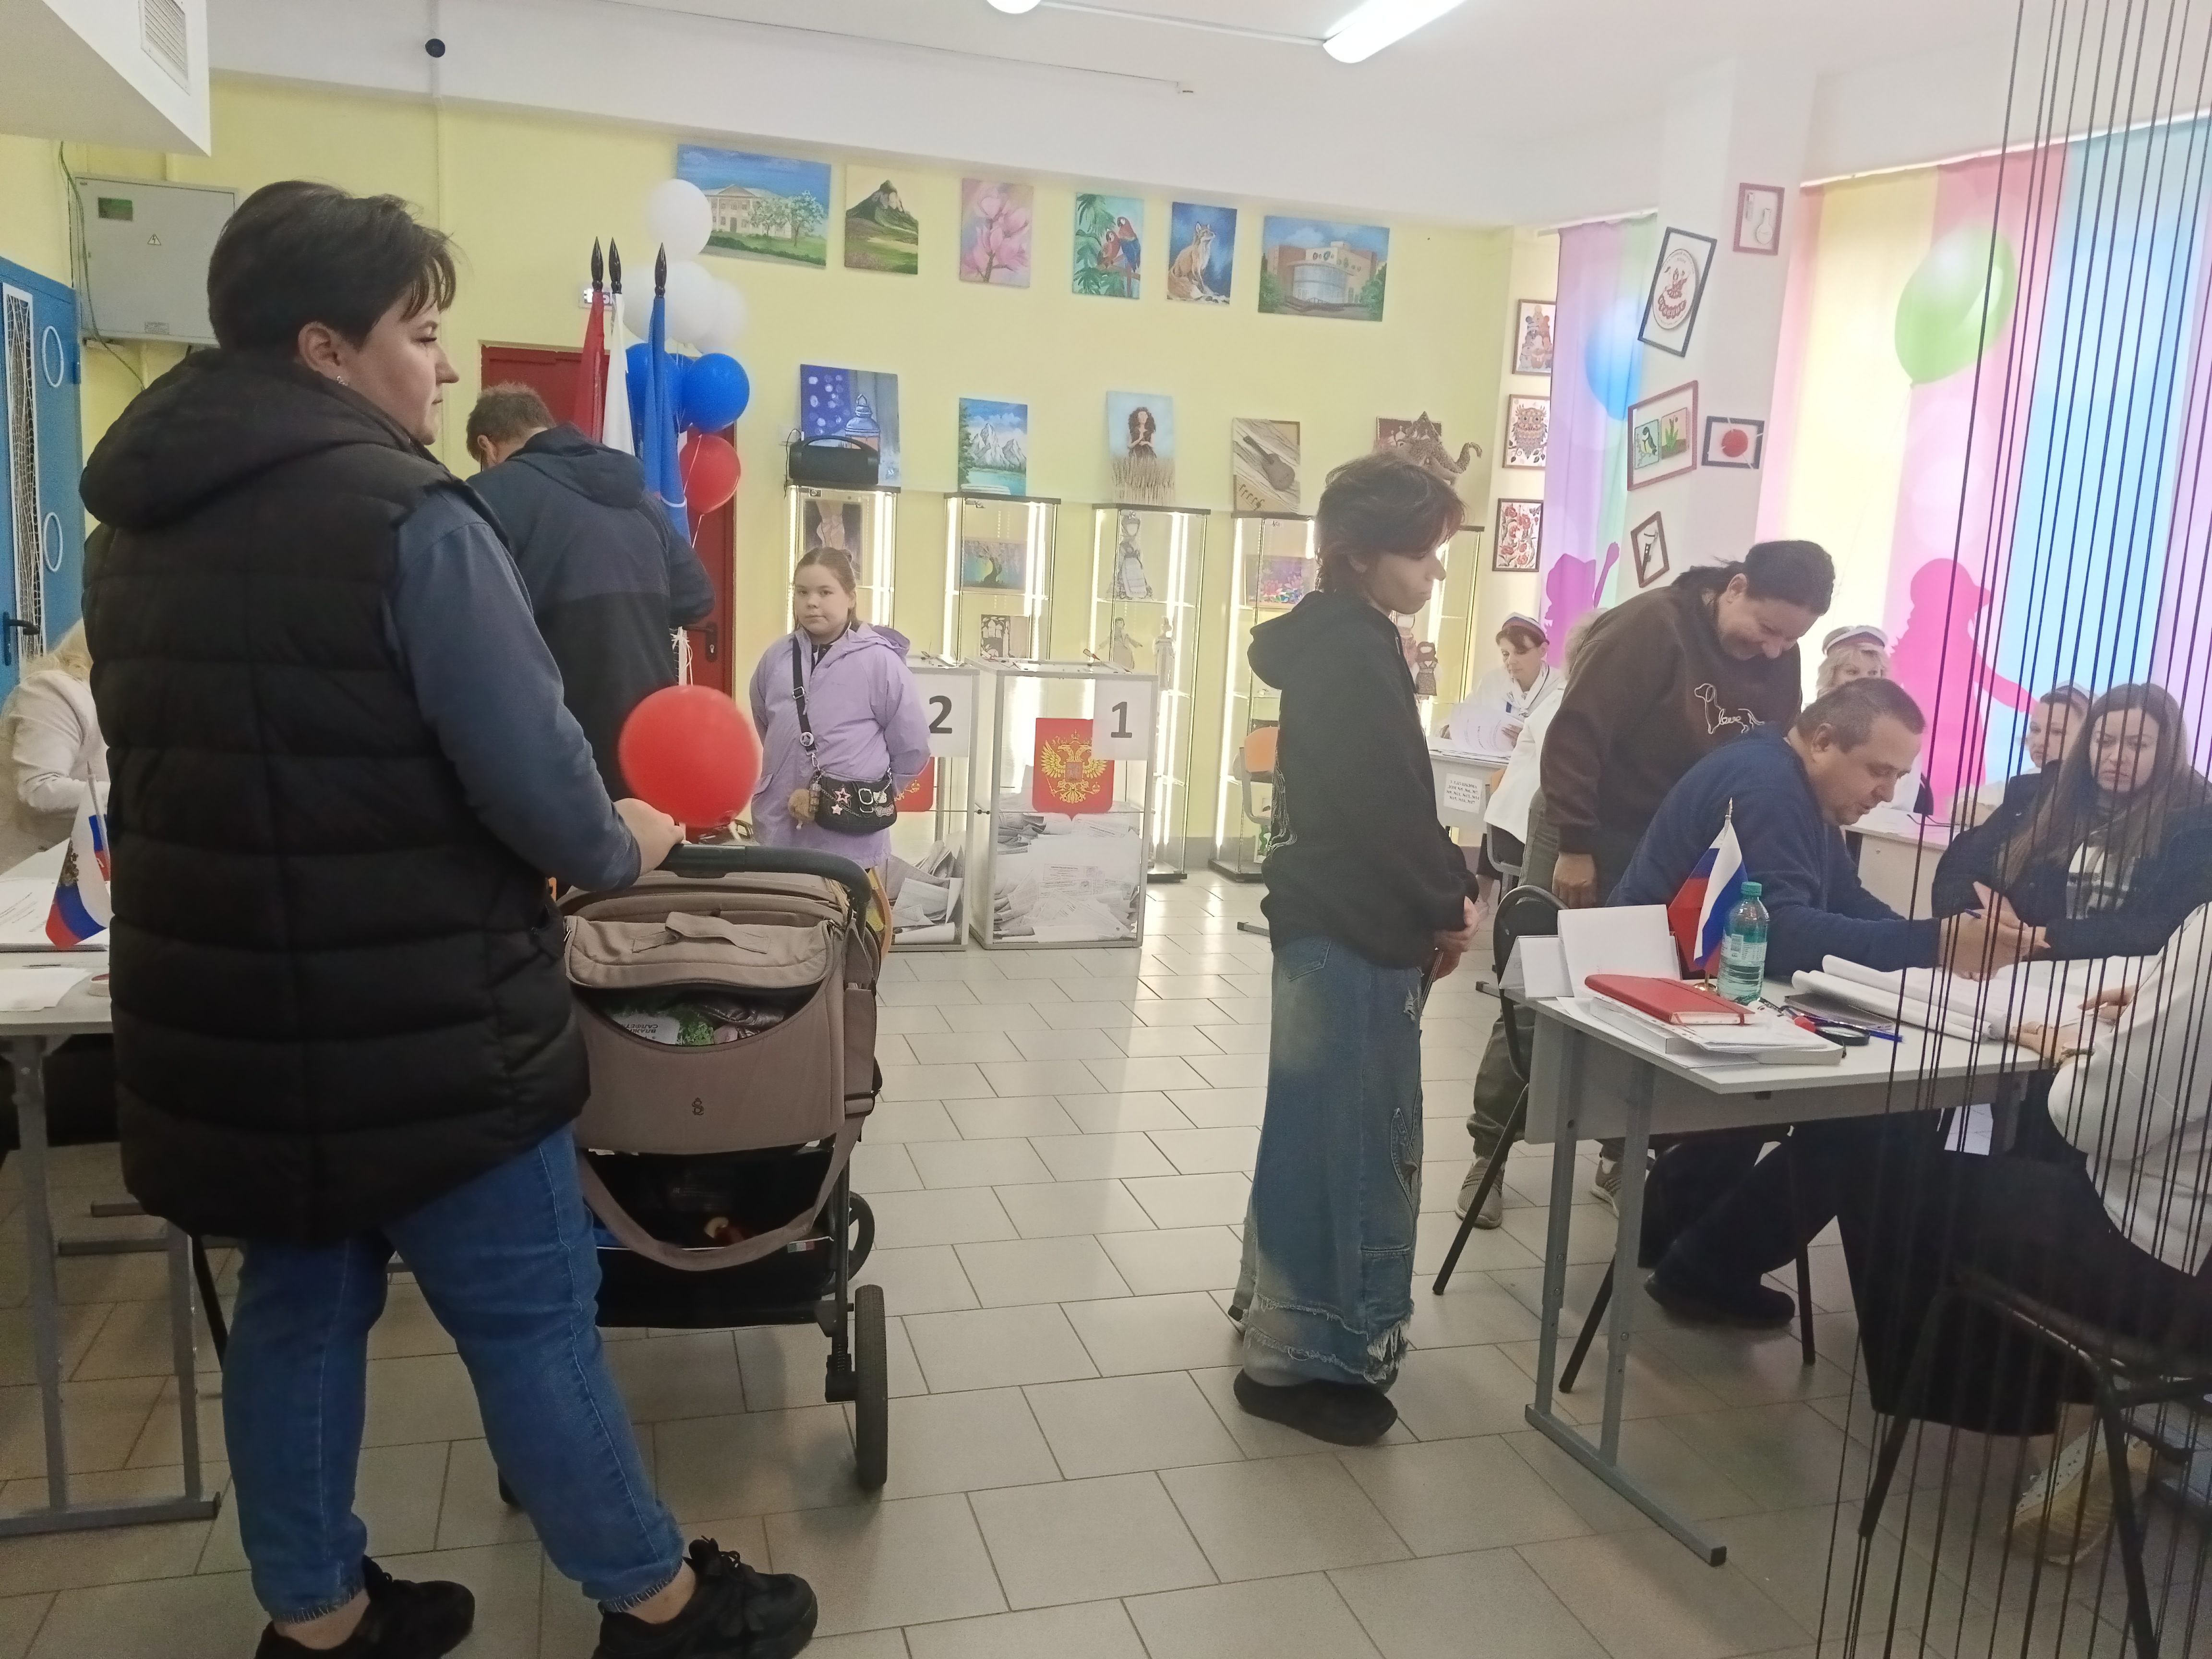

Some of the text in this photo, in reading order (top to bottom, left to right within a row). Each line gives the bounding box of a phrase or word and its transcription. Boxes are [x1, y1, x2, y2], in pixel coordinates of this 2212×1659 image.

[929, 696, 952, 734] 2
[1111, 701, 1132, 738] 1
[1719, 708, 1741, 725] love
